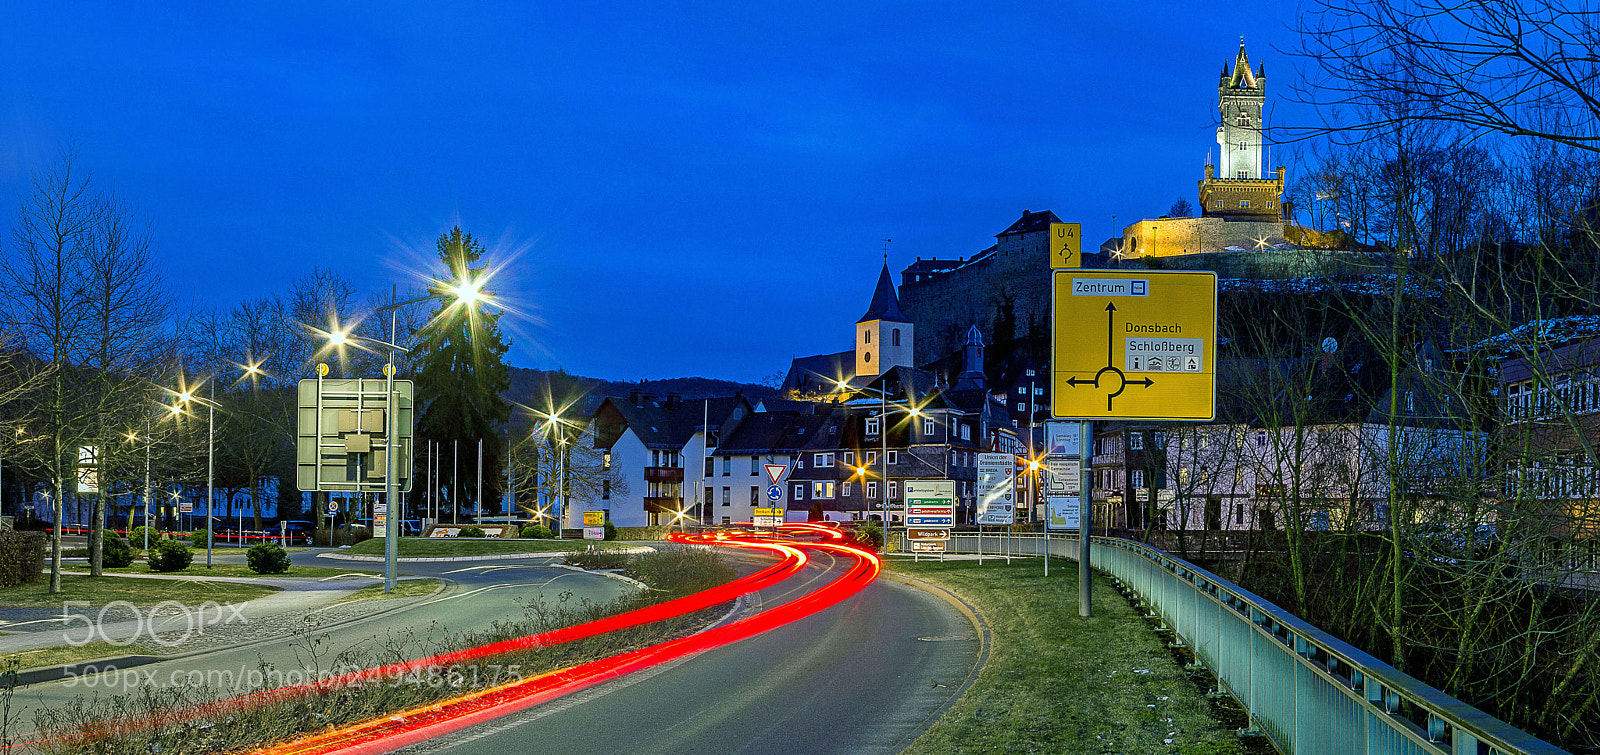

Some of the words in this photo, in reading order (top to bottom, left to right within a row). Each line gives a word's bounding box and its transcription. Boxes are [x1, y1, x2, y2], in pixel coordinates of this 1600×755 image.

[1076, 281, 1125, 293] Zentrum
[1125, 322, 1182, 333] Donsbach
[1129, 341, 1195, 354] Schloßberg
